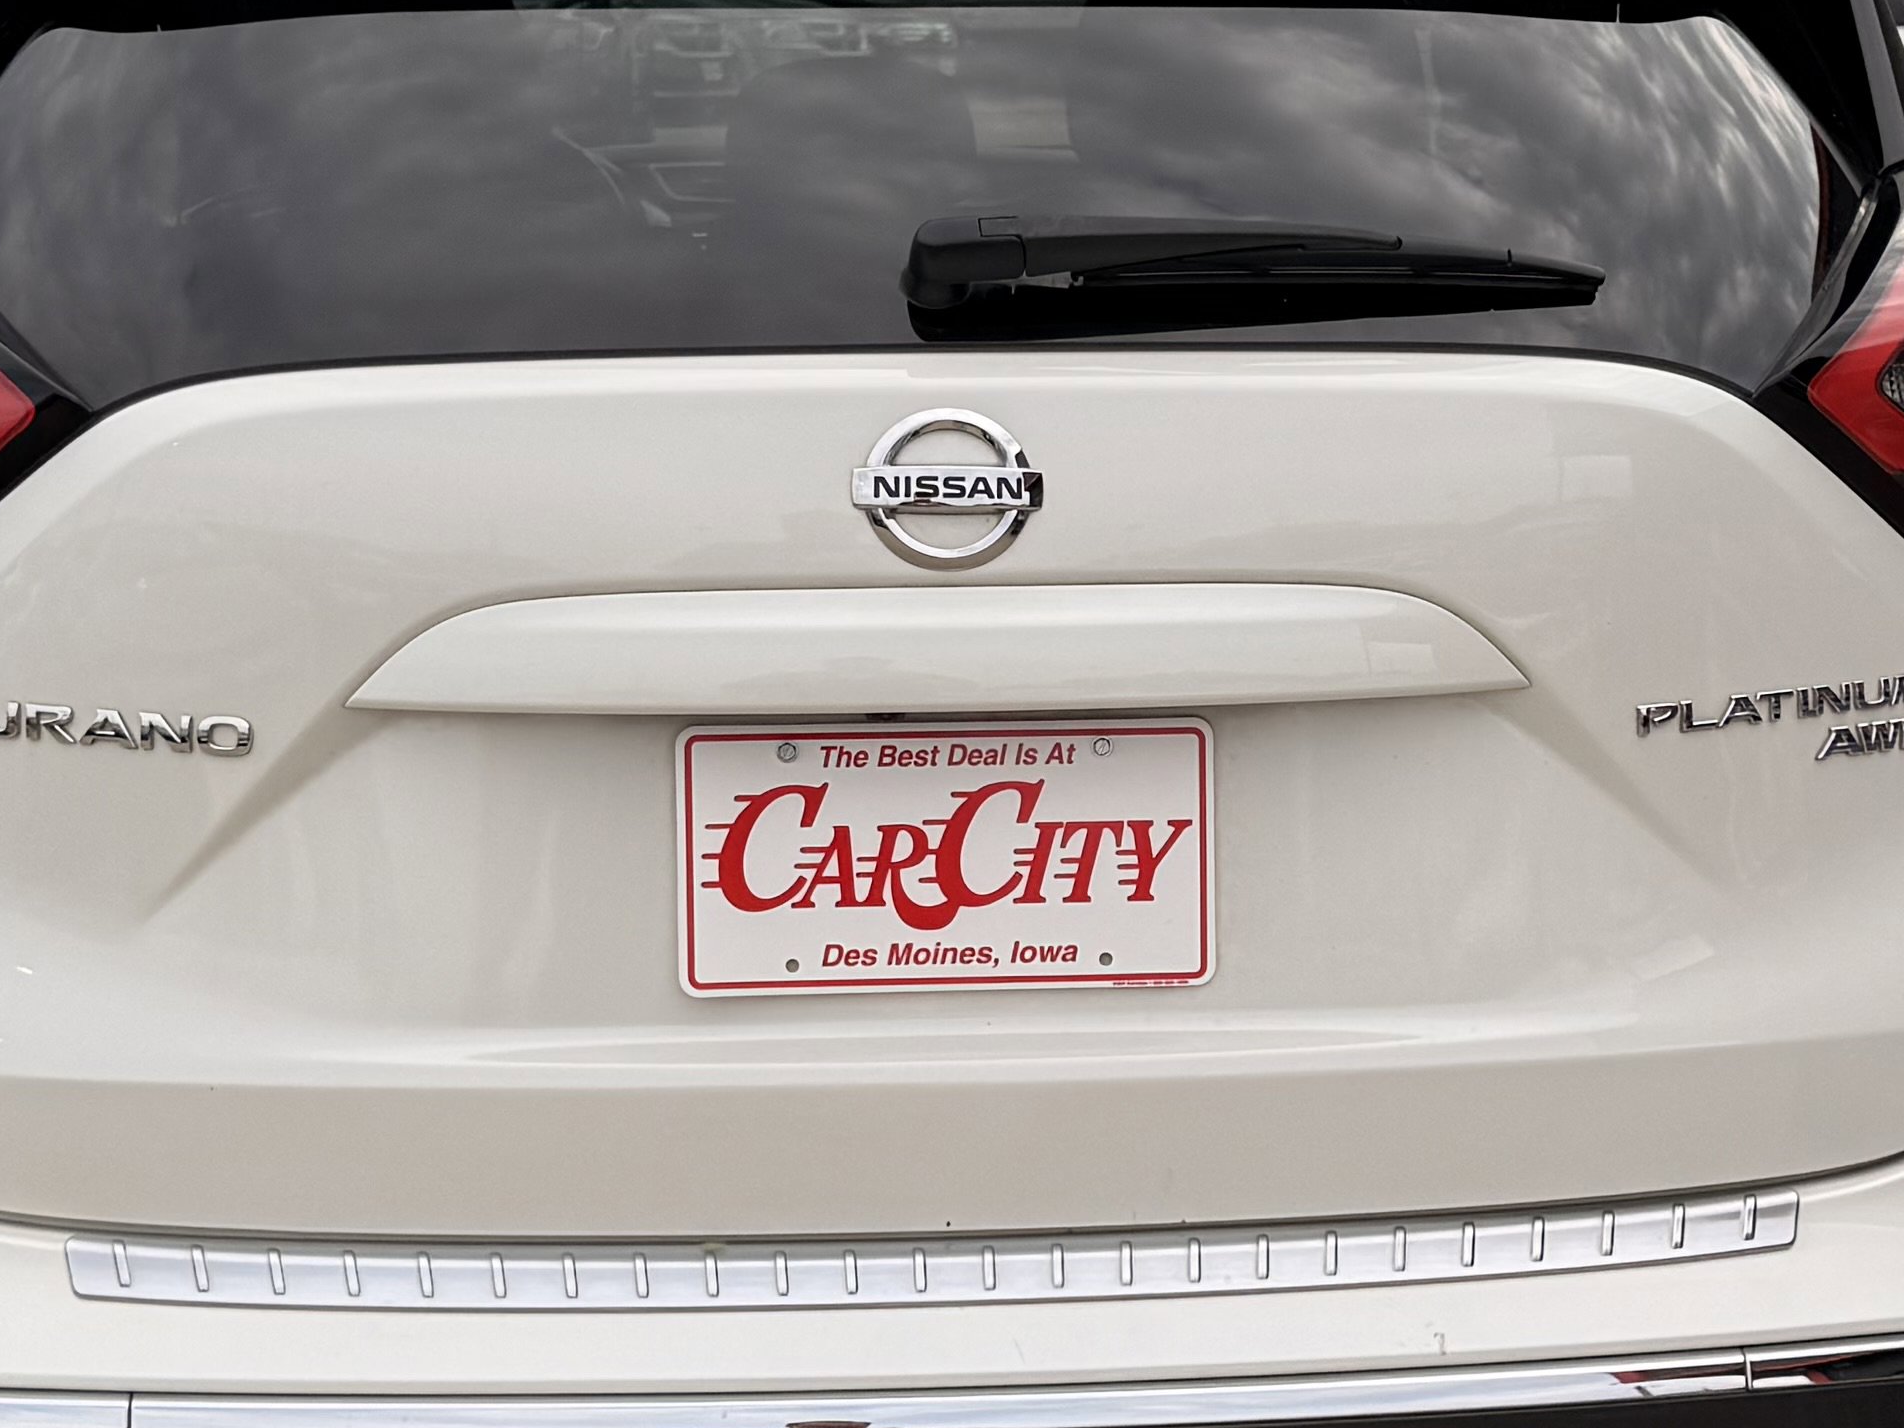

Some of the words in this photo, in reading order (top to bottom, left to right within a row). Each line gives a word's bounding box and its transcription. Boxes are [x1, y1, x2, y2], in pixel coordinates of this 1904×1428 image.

[872, 475, 1024, 500] NISSAN
[819, 745, 870, 768] The
[876, 744, 941, 768] Best
[946, 742, 1008, 767] Deal
[1014, 742, 1039, 766] Is
[1044, 741, 1077, 765] At
[821, 943, 879, 967] Des
[886, 941, 1000, 969] Moines,
[1009, 940, 1079, 964] Iowa
